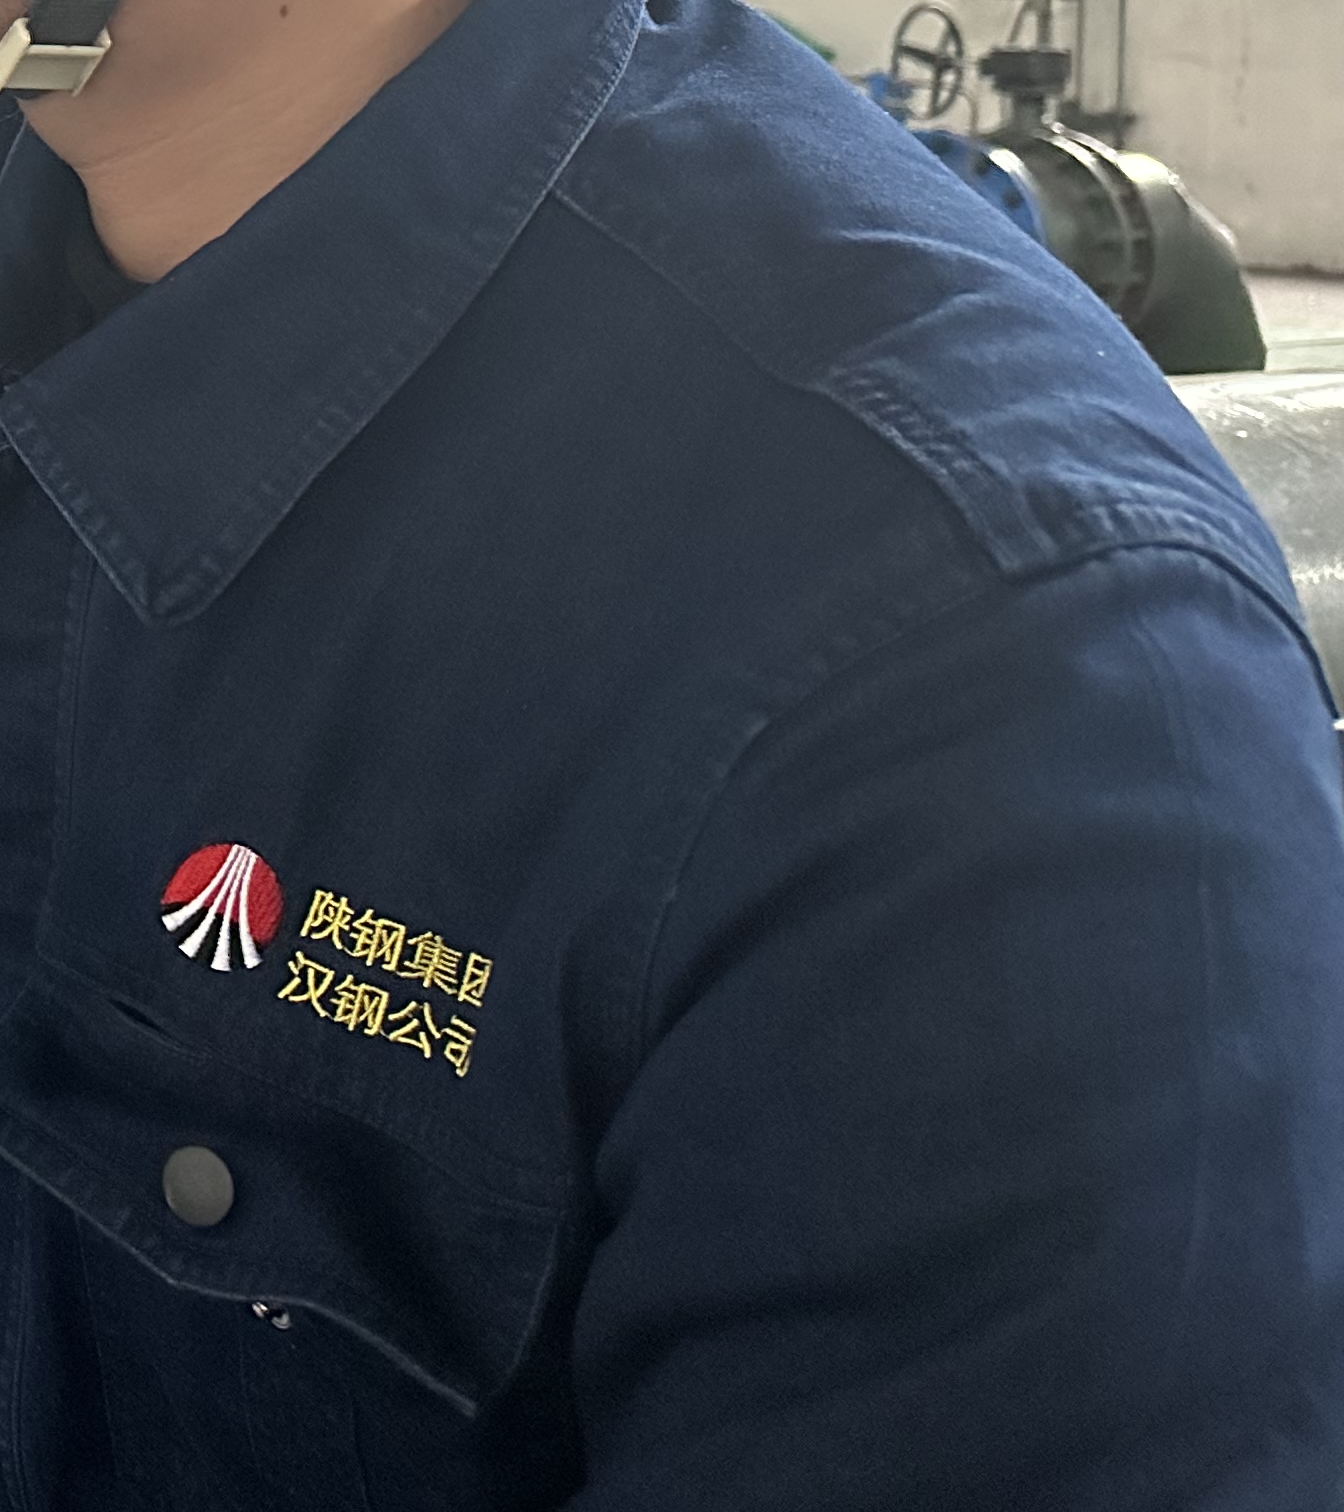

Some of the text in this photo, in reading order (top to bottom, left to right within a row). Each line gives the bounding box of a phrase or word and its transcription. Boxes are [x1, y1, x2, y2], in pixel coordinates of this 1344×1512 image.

[299, 889, 494, 1007] 陕钢集团
[277, 950, 478, 1077] 汉钢公司
